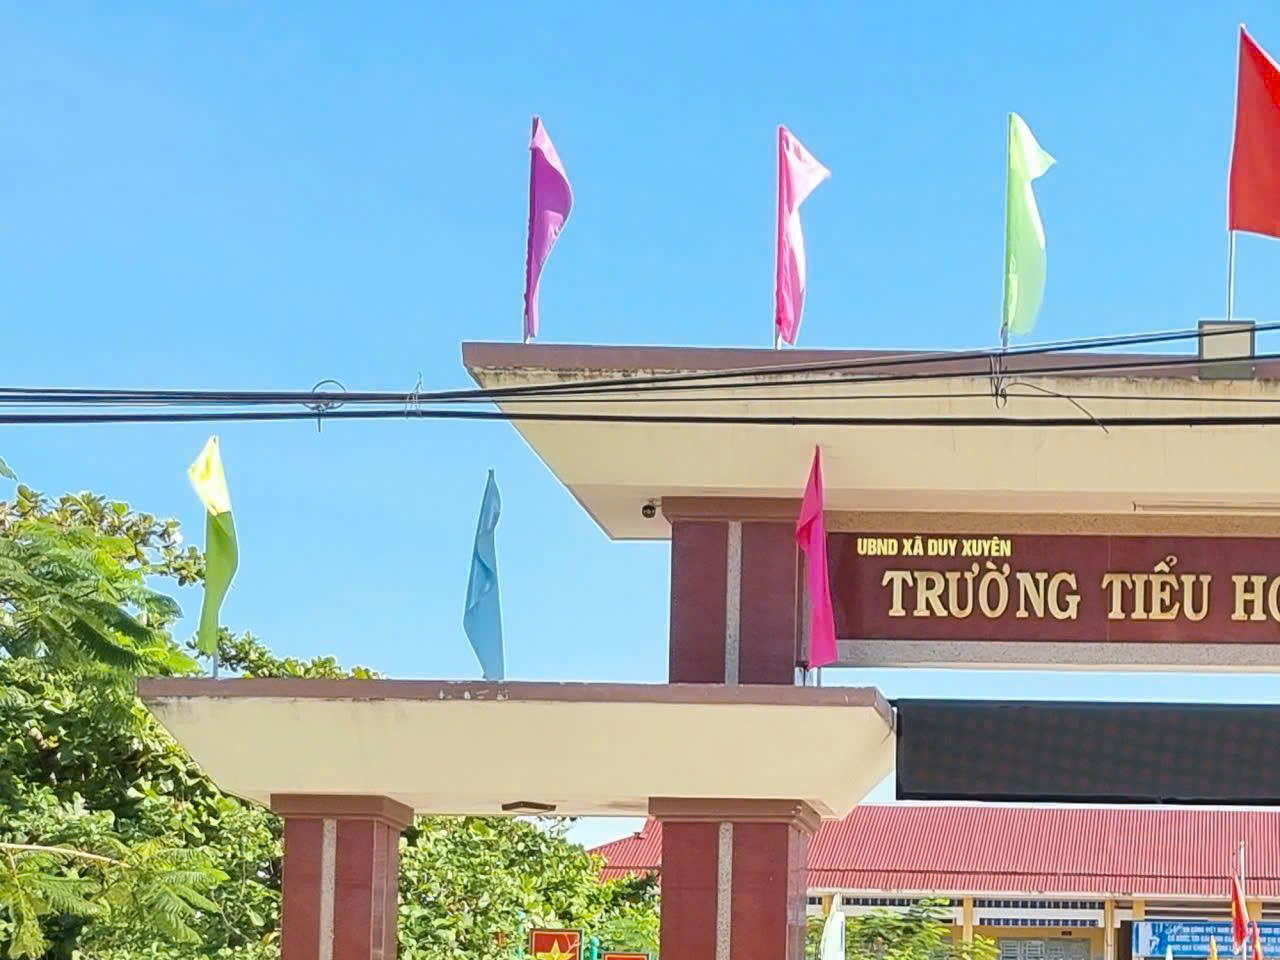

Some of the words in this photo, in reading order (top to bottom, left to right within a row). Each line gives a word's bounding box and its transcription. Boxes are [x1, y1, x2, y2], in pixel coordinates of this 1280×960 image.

[857, 538, 898, 556] UBND
[902, 536, 924, 556] XÃ
[928, 539, 957, 556] DUY
[961, 536, 1012, 557] XUYÊN
[881, 560, 1081, 620] TRƯỜNG
[1101, 555, 1212, 621] TIỂU
